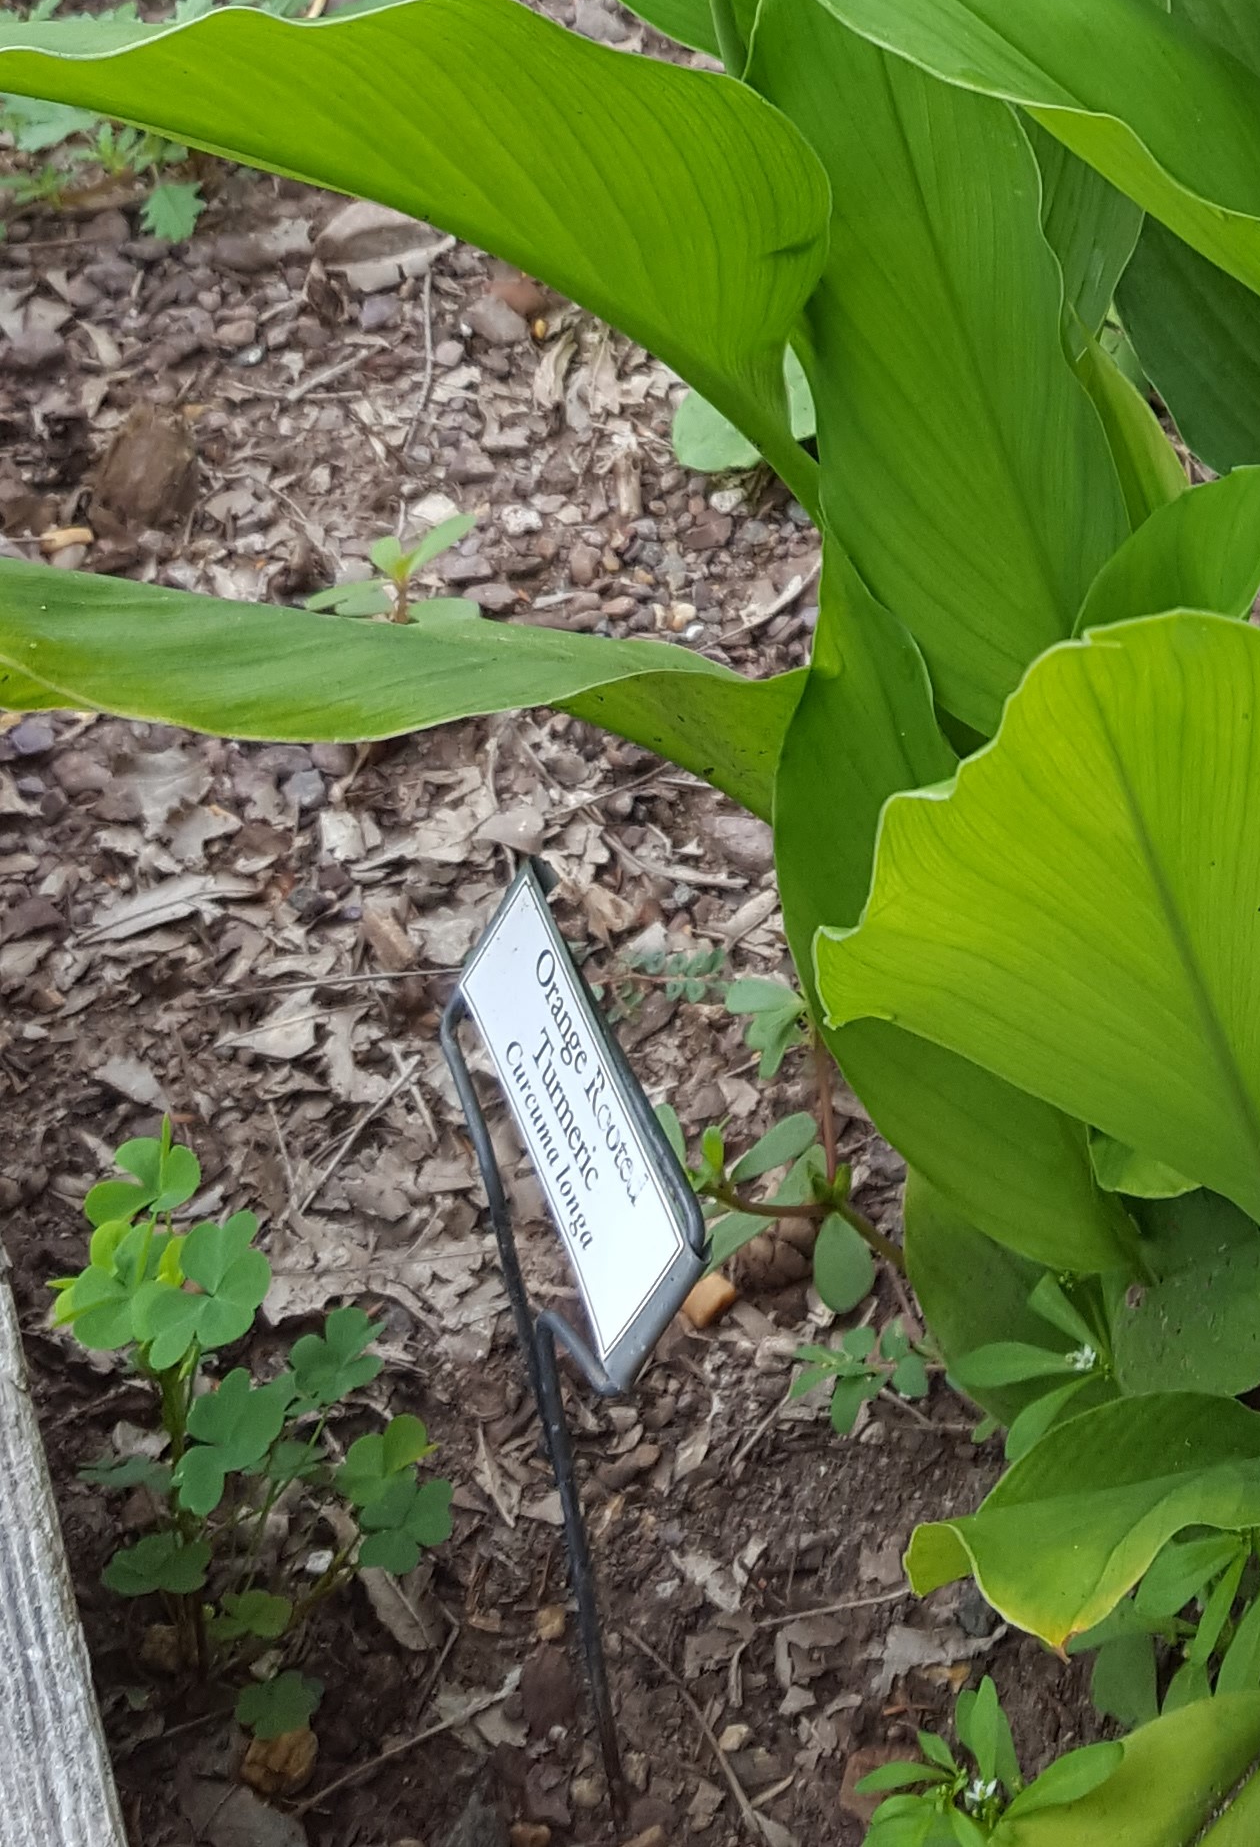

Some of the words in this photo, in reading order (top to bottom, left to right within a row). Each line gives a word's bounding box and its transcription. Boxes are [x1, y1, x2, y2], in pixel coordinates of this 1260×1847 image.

[536, 949, 588, 1074] Orange
[506, 1040, 561, 1167] Curcuma
[555, 1164, 595, 1252] longa
[532, 1027, 599, 1191] Turmeric
